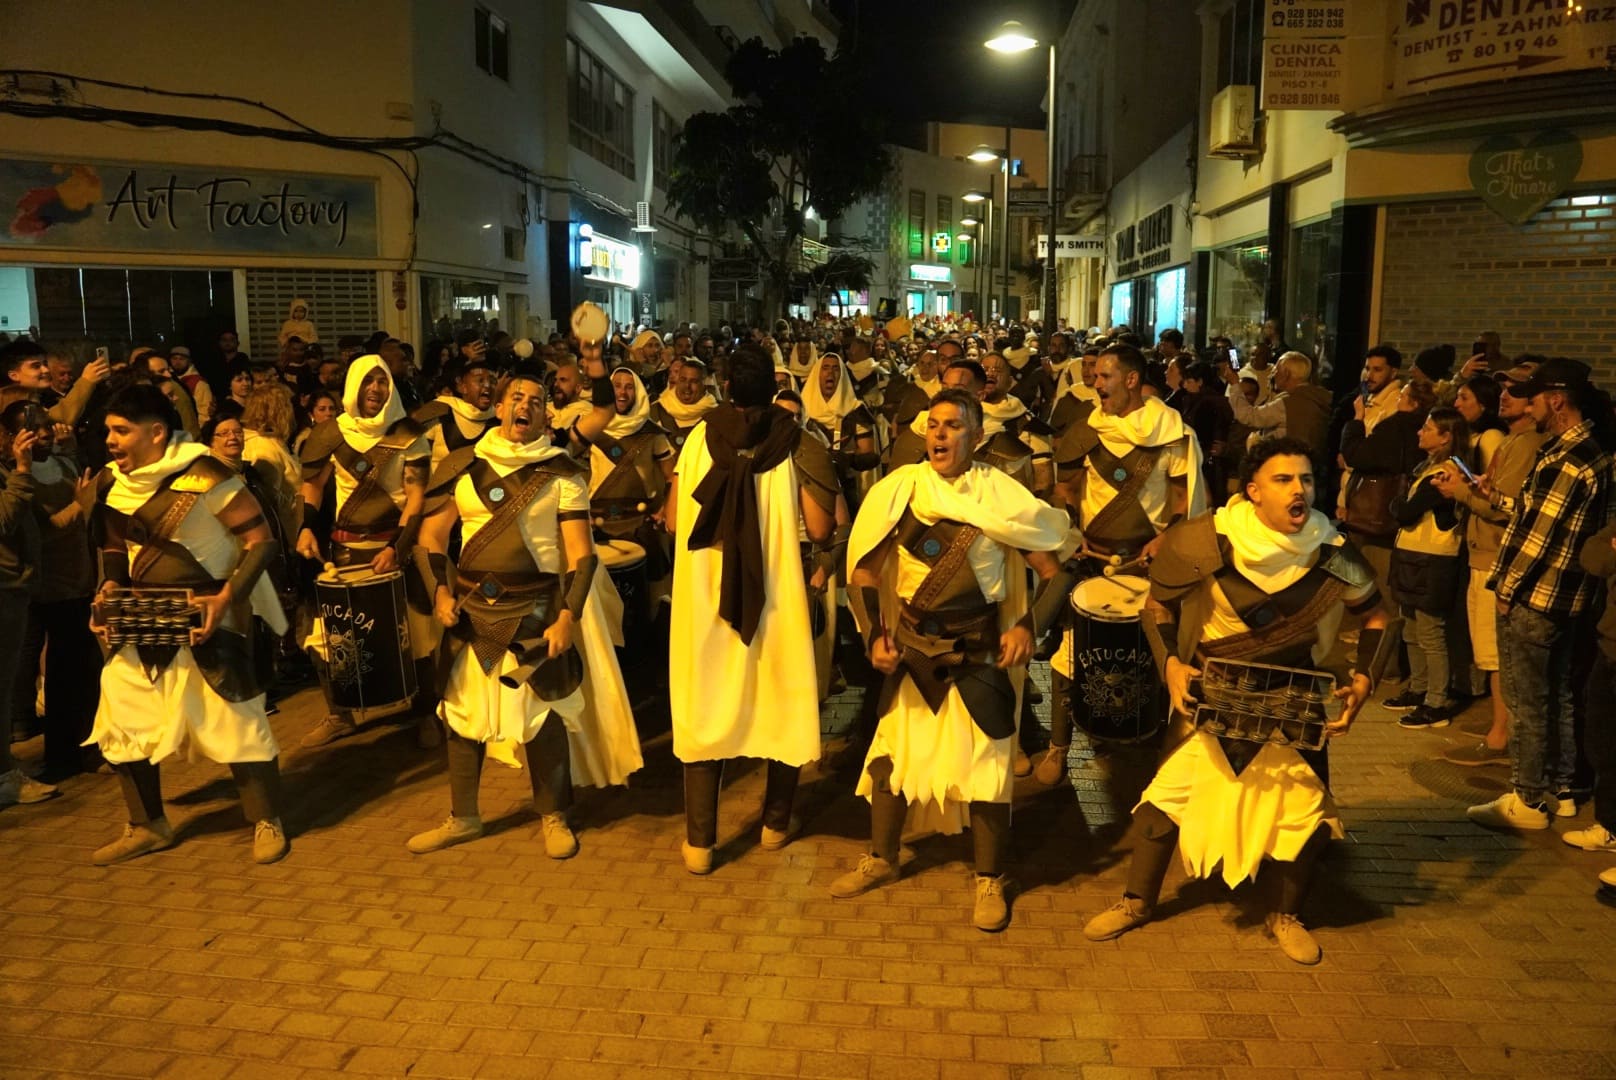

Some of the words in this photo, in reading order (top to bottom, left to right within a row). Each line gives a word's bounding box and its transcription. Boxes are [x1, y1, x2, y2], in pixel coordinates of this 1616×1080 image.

[1404, 29, 1474, 57] DENTIST
[1473, 44, 1496, 58] 80
[1504, 38, 1526, 53] 19
[1533, 34, 1558, 48] 46
[1270, 44, 1341, 55] CLINICA
[1275, 57, 1336, 68] DENTAL
[1282, 80, 1307, 88] PISO
[105, 170, 198, 230] Art
[195, 177, 350, 248] Factory
[1040, 241, 1064, 249] TM
[1068, 240, 1104, 249] SMITH
